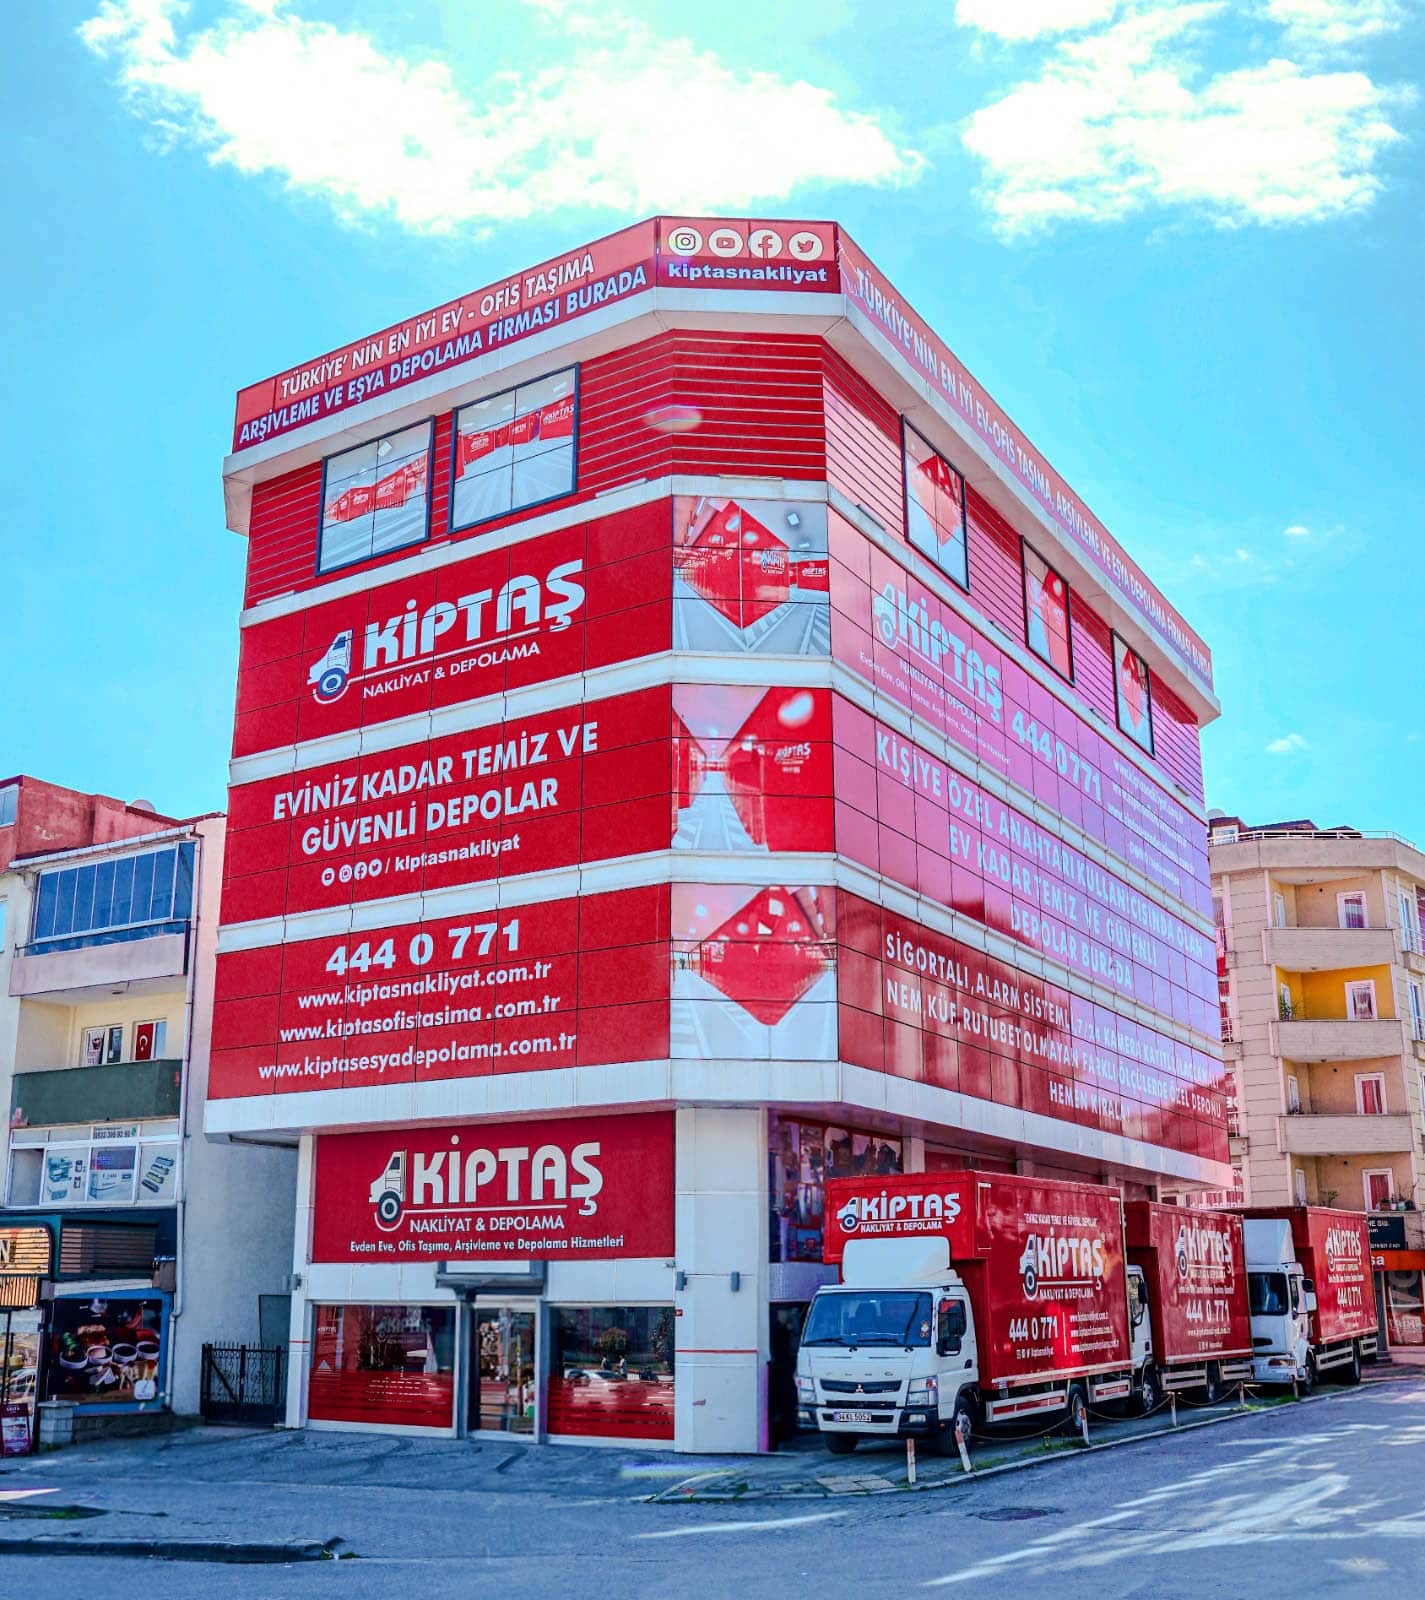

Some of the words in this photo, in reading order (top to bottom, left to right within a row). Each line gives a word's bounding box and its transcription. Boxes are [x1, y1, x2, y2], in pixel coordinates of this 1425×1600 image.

[668, 263, 827, 284] kiptasnakliyat
[388, 329, 411, 356] EN
[415, 318, 436, 344] İYİ
[441, 307, 464, 334] EV
[480, 281, 520, 317] OFİS
[526, 254, 594, 295] TAŞIMA
[239, 395, 320, 444] ARŞİVLEME
[324, 386, 344, 410] VE
[347, 372, 384, 403] EŞYA
[389, 330, 484, 385] DEPOLAMA
[488, 300, 560, 345] FİRMASI
[566, 265, 647, 312] BURADA
[941, 360, 957, 399] EN
[959, 374, 974, 417] İYİ
[364, 558, 586, 671] KİPTAŞ
[363, 669, 429, 699] NAKLİYAT
[434, 667, 446, 680] &
[450, 641, 541, 676] DEPOLAMA
[898, 591, 1003, 723] KİPTAŞ
[273, 774, 358, 820] EVİNİZ
[362, 756, 453, 799] KADAR
[461, 731, 549, 779] TEMİZ
[557, 722, 598, 756] VE
[1012, 710, 1052, 763] 444
[1055, 741, 1067, 775] 0
[1070, 752, 1101, 801] 771
[301, 800, 416, 855] GÜVENLİ
[426, 778, 558, 831] DEPOLAR
[876, 731, 941, 797] KİŞİYE
[948, 773, 993, 829] ÖZEL
[999, 810, 1074, 879] ANAHTARI
[395, 834, 520, 872] kiptasnakliyat
[949, 825, 970, 859] EV
[977, 840, 1032, 895] KADAR
[1034, 875, 1077, 921] TEMİZ
[1085, 903, 1100, 934] VE
[326, 938, 396, 976] 444
[408, 933, 434, 965] 0
[448, 919, 519, 959] 771
[1011, 905, 1077, 962] DEPOLAR
[298, 961, 552, 1008] www.kiptasnakliyat.com.tr
[259, 1032, 577, 1079] www.kiptasesyadepolama.com.tr
[1049, 1080, 1088, 1111] HEMEN
[412, 1134, 604, 1216] KİPTAŞ
[409, 1215, 472, 1233] NAKLİYAT
[475, 1219, 485, 1231] &
[489, 1215, 565, 1231] DEPOLAMA
[861, 1190, 961, 1224] KİPTAŞ
[903, 1221, 943, 1231] DEPOLAMA
[350, 1241, 376, 1253] Evden
[378, 1241, 396, 1253] Eve,
[398, 1240, 416, 1251] Ofis
[418, 1240, 452, 1254] Taşıma,
[455, 1239, 501, 1253] Arşivleme
[503, 1242, 514, 1250] ve
[517, 1238, 568, 1253] Depolama
[570, 1235, 624, 1250] Hizmetleri
[1037, 1227, 1104, 1290] KİPTAŞ
[1009, 1318, 1028, 1342] 444
[1031, 1317, 1038, 1340] 0
[1040, 1316, 1058, 1339] 771
[1186, 1299, 1203, 1322] 444
[1206, 1300, 1212, 1323] 0
[1214, 1300, 1230, 1322] 771
